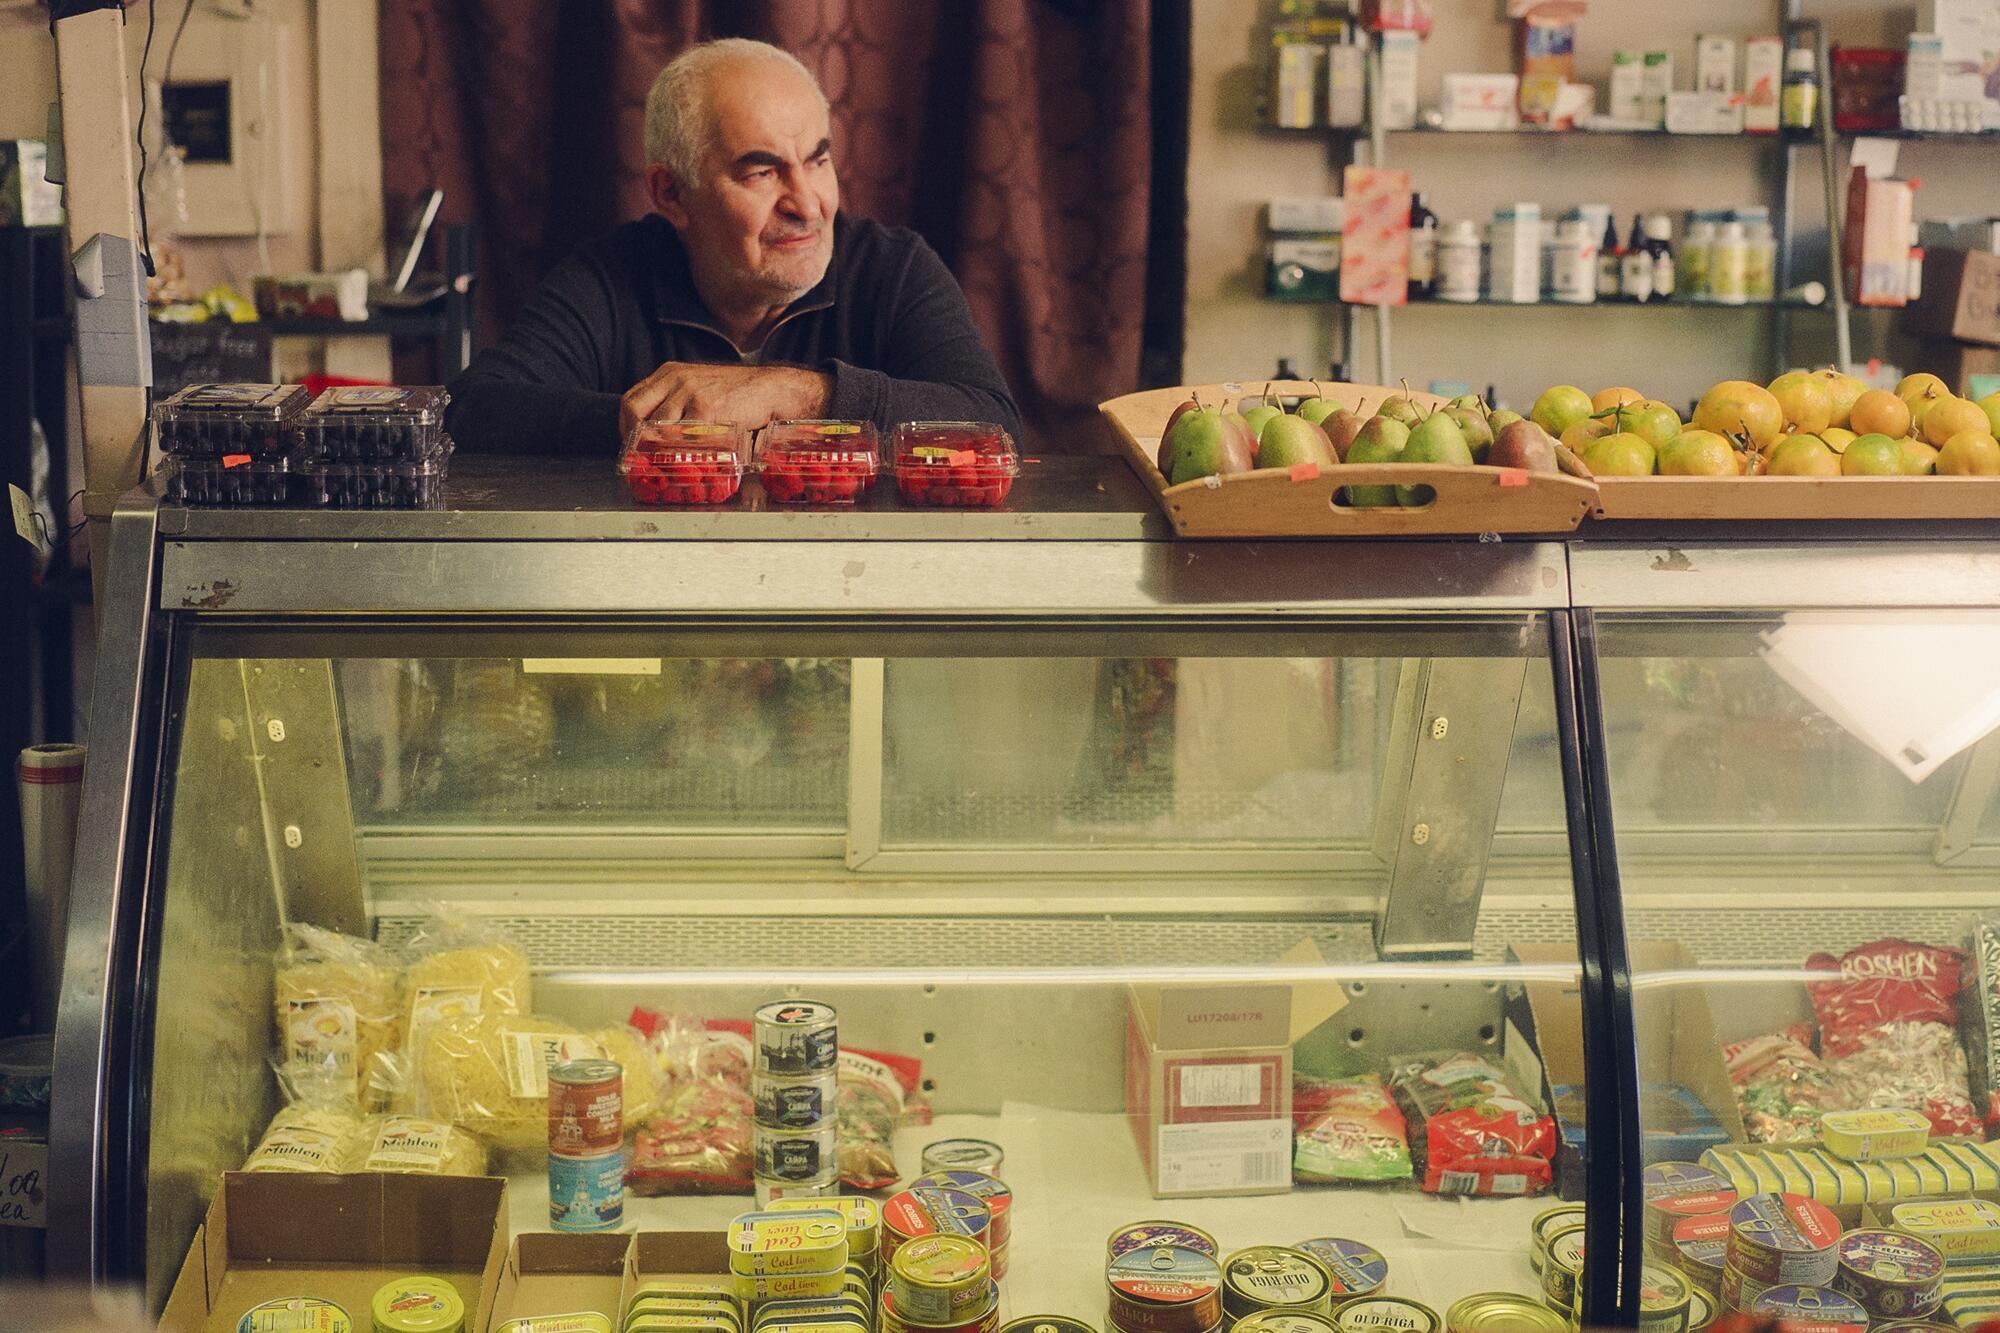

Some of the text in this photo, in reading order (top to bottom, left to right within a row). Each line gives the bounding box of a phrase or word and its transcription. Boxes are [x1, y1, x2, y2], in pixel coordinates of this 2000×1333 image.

[1840, 952, 1937, 980] ROSHEN
[1674, 1195, 1718, 1207] GOBIES
[902, 1203, 925, 1230] GOBIES
[1931, 1206, 1967, 1217] Cod
[1795, 1205, 1822, 1236] GOBIES
[1693, 1225, 1728, 1235] OBIES
[764, 1236, 803, 1251] Cod
[1946, 1236, 1967, 1250] Cod
[771, 1254, 794, 1268] Cod
[774, 1279, 797, 1293] Cod
[1248, 1273, 1310, 1288] OLD RIGA
[1354, 1314, 1415, 1328] OLD RIGA
